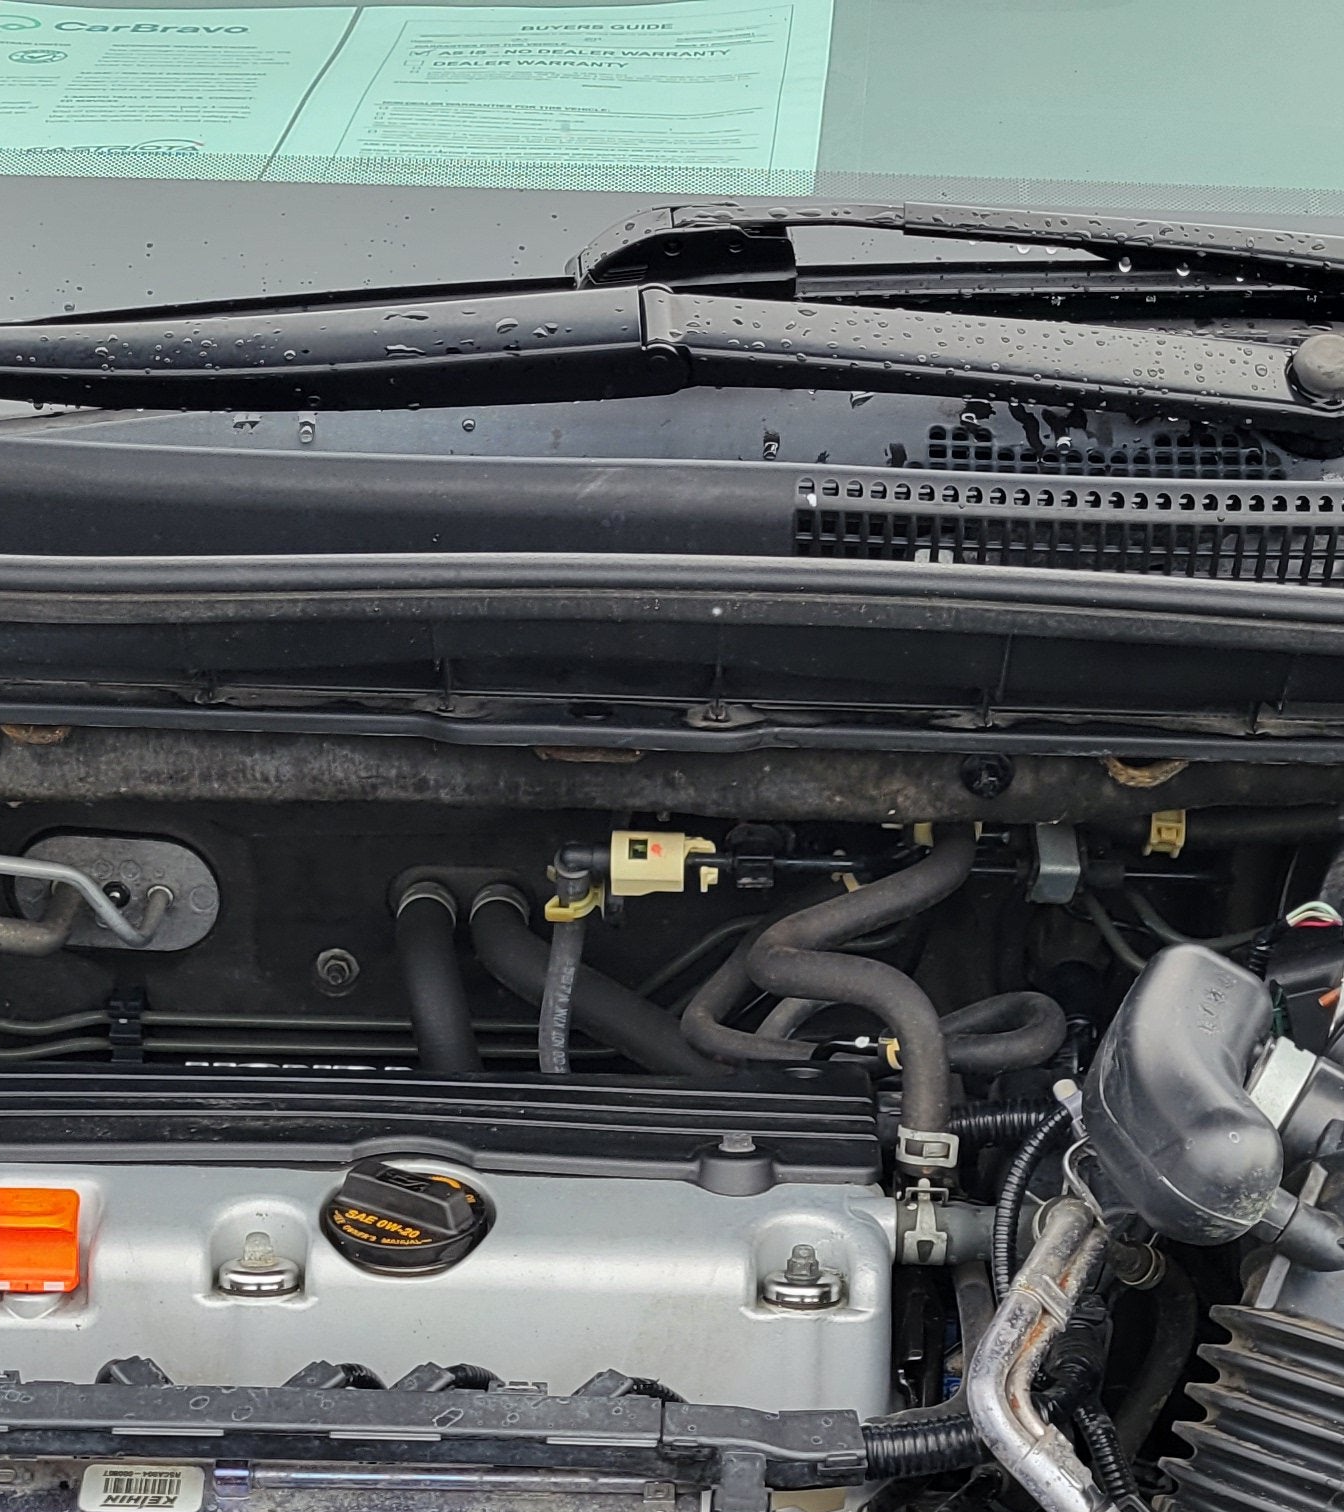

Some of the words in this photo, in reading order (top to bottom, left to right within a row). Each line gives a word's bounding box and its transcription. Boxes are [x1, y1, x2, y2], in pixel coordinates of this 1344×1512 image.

[54, 20, 249, 34] CarBravo
[611, 23, 674, 31] GUIDE
[622, 49, 732, 57] WARRANTY
[516, 60, 630, 68] WARRANTY
[345, 1209, 378, 1226] SAE
[376, 1219, 422, 1239] 0W-20
[103, 1494, 179, 1509] KEIHIN
